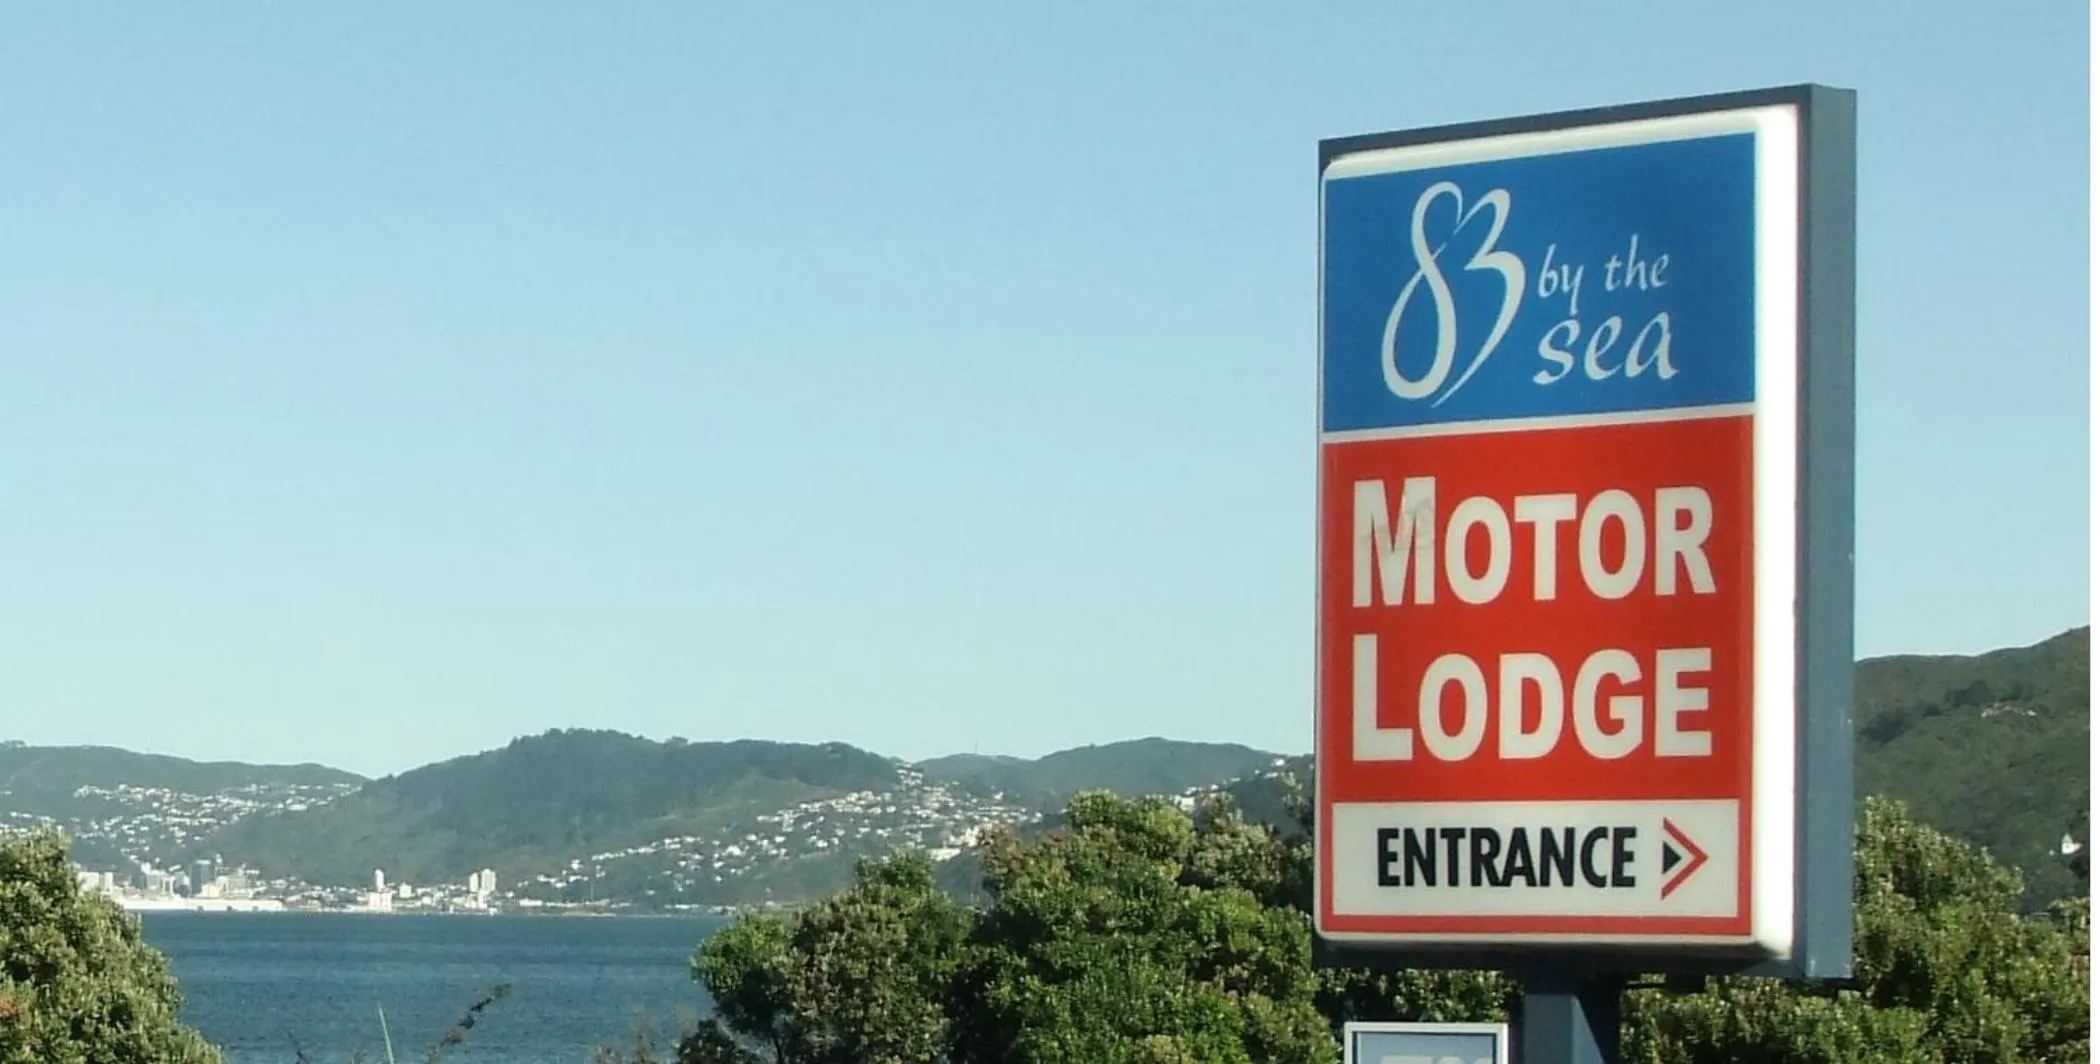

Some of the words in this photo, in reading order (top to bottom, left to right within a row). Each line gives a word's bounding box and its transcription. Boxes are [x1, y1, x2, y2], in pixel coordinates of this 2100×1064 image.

[1381, 181, 1526, 408] 83
[1538, 243, 1584, 316] by
[1604, 234, 1670, 290] the
[1533, 312, 1678, 385] sea
[1353, 476, 1716, 608] MOTOR
[1352, 633, 1713, 762] LODGE
[1376, 826, 1637, 888] ENTRANCE
